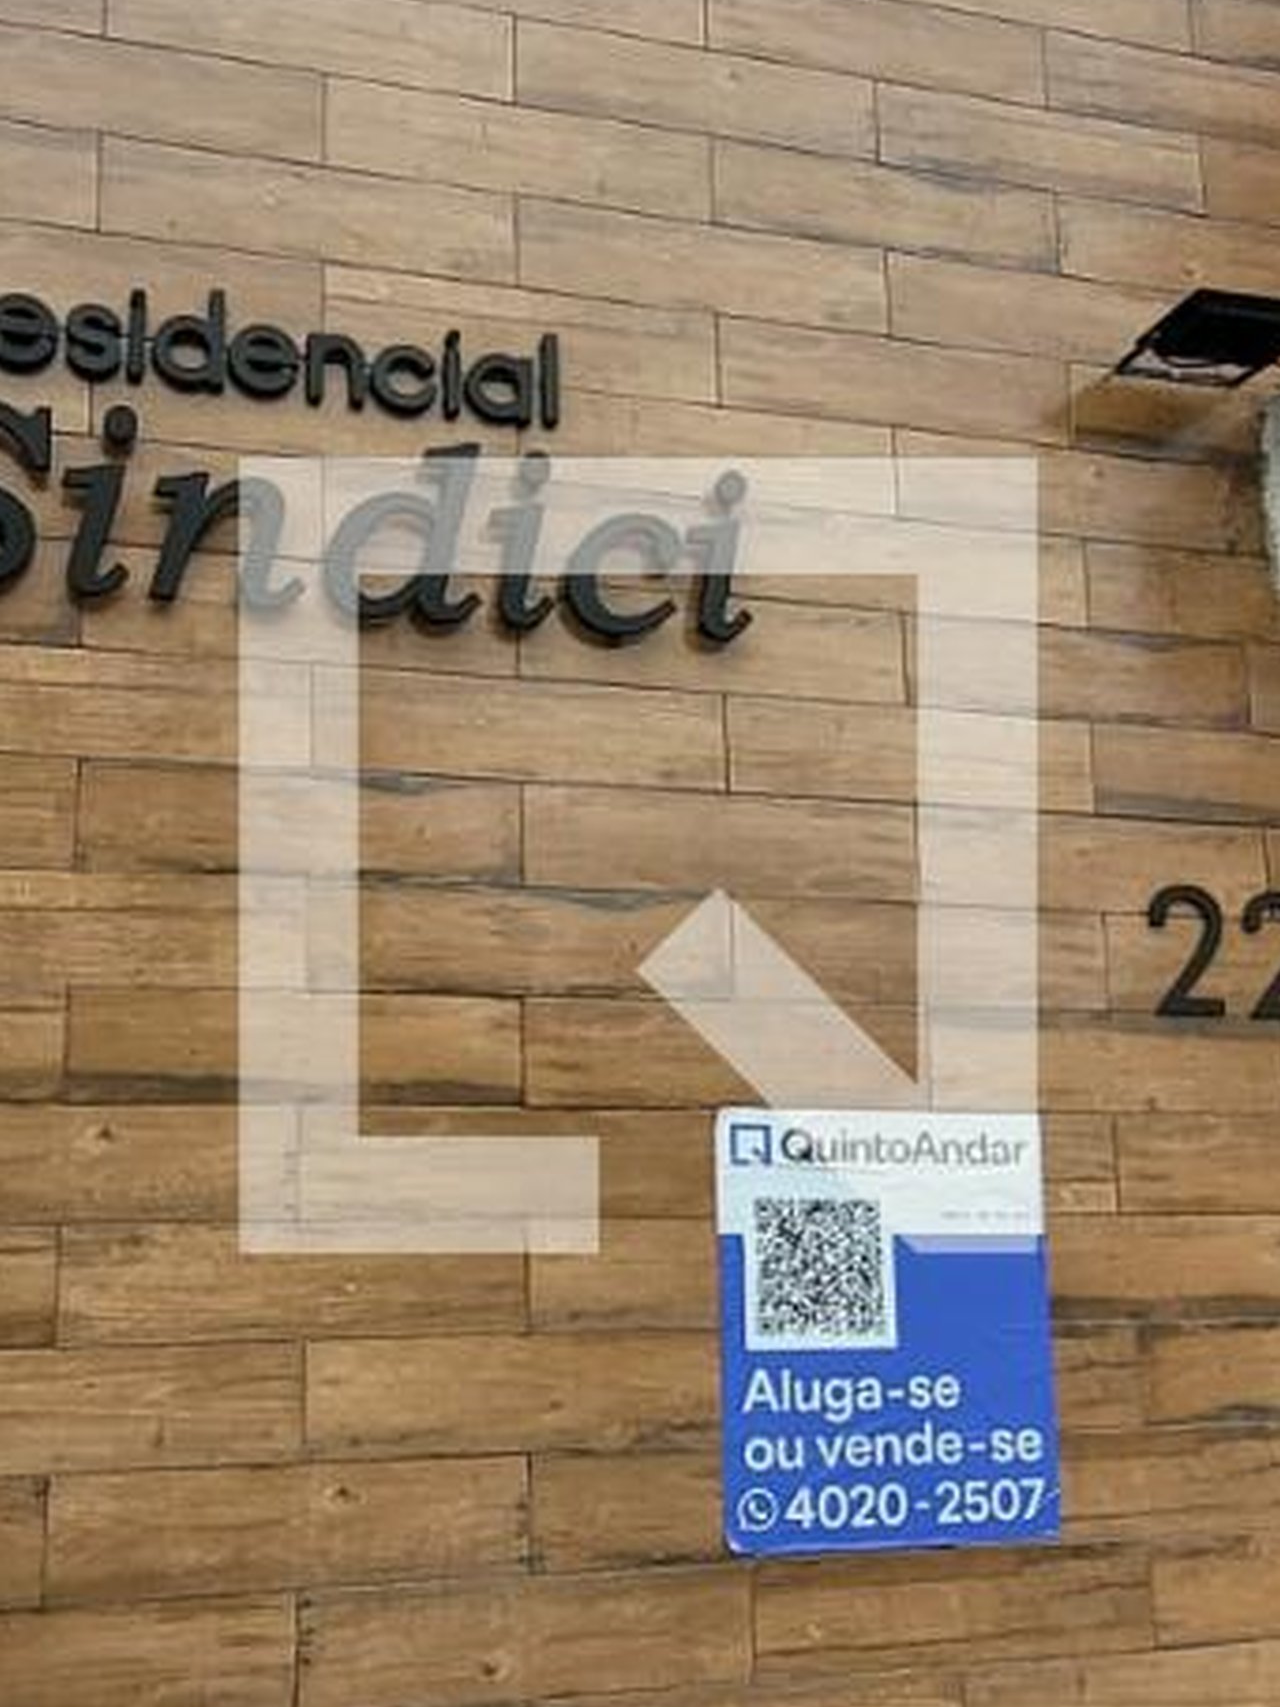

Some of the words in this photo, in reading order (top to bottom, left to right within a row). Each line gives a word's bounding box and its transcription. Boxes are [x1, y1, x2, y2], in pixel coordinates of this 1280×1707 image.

[780, 1127, 1027, 1166] QuintoAndar
[741, 1369, 961, 1423] Aluga-se
[744, 1436, 803, 1471] ou
[816, 1422, 1043, 1468] vende-se
